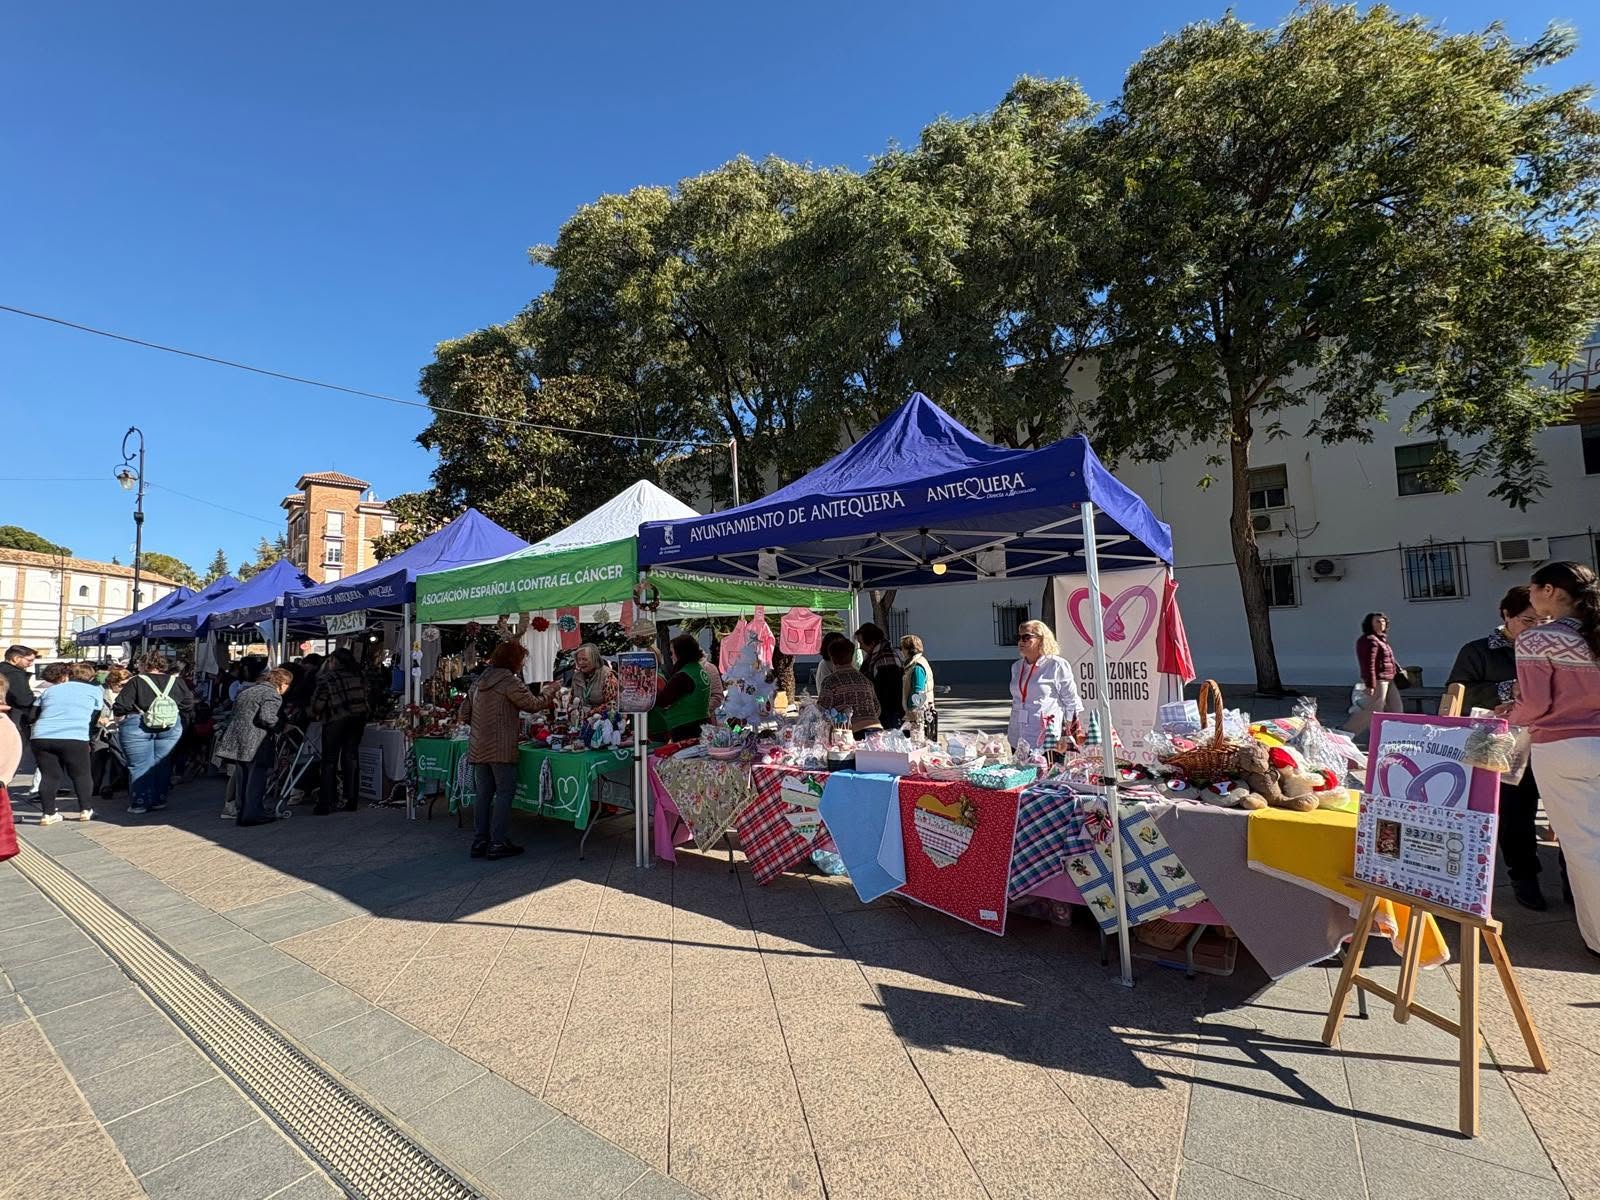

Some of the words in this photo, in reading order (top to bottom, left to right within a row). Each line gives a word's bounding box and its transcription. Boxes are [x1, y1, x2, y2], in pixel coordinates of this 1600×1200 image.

[927, 472, 1026, 502] ANTEQUERA
[690, 510, 785, 542] AYUNTAMIENTO
[788, 507, 807, 524] DE
[810, 490, 906, 522] ANTEQUERA
[421, 586, 470, 606] ASOCIACIÓN
[470, 581, 516, 599] ESPAÑOLA
[517, 574, 558, 592] CONTRA
[559, 572, 573, 586] EL
[574, 564, 624, 584] CÁNCER
[1080, 662, 1147, 680] COZONES
[1426, 742, 1466, 762] SOLIDARIO
